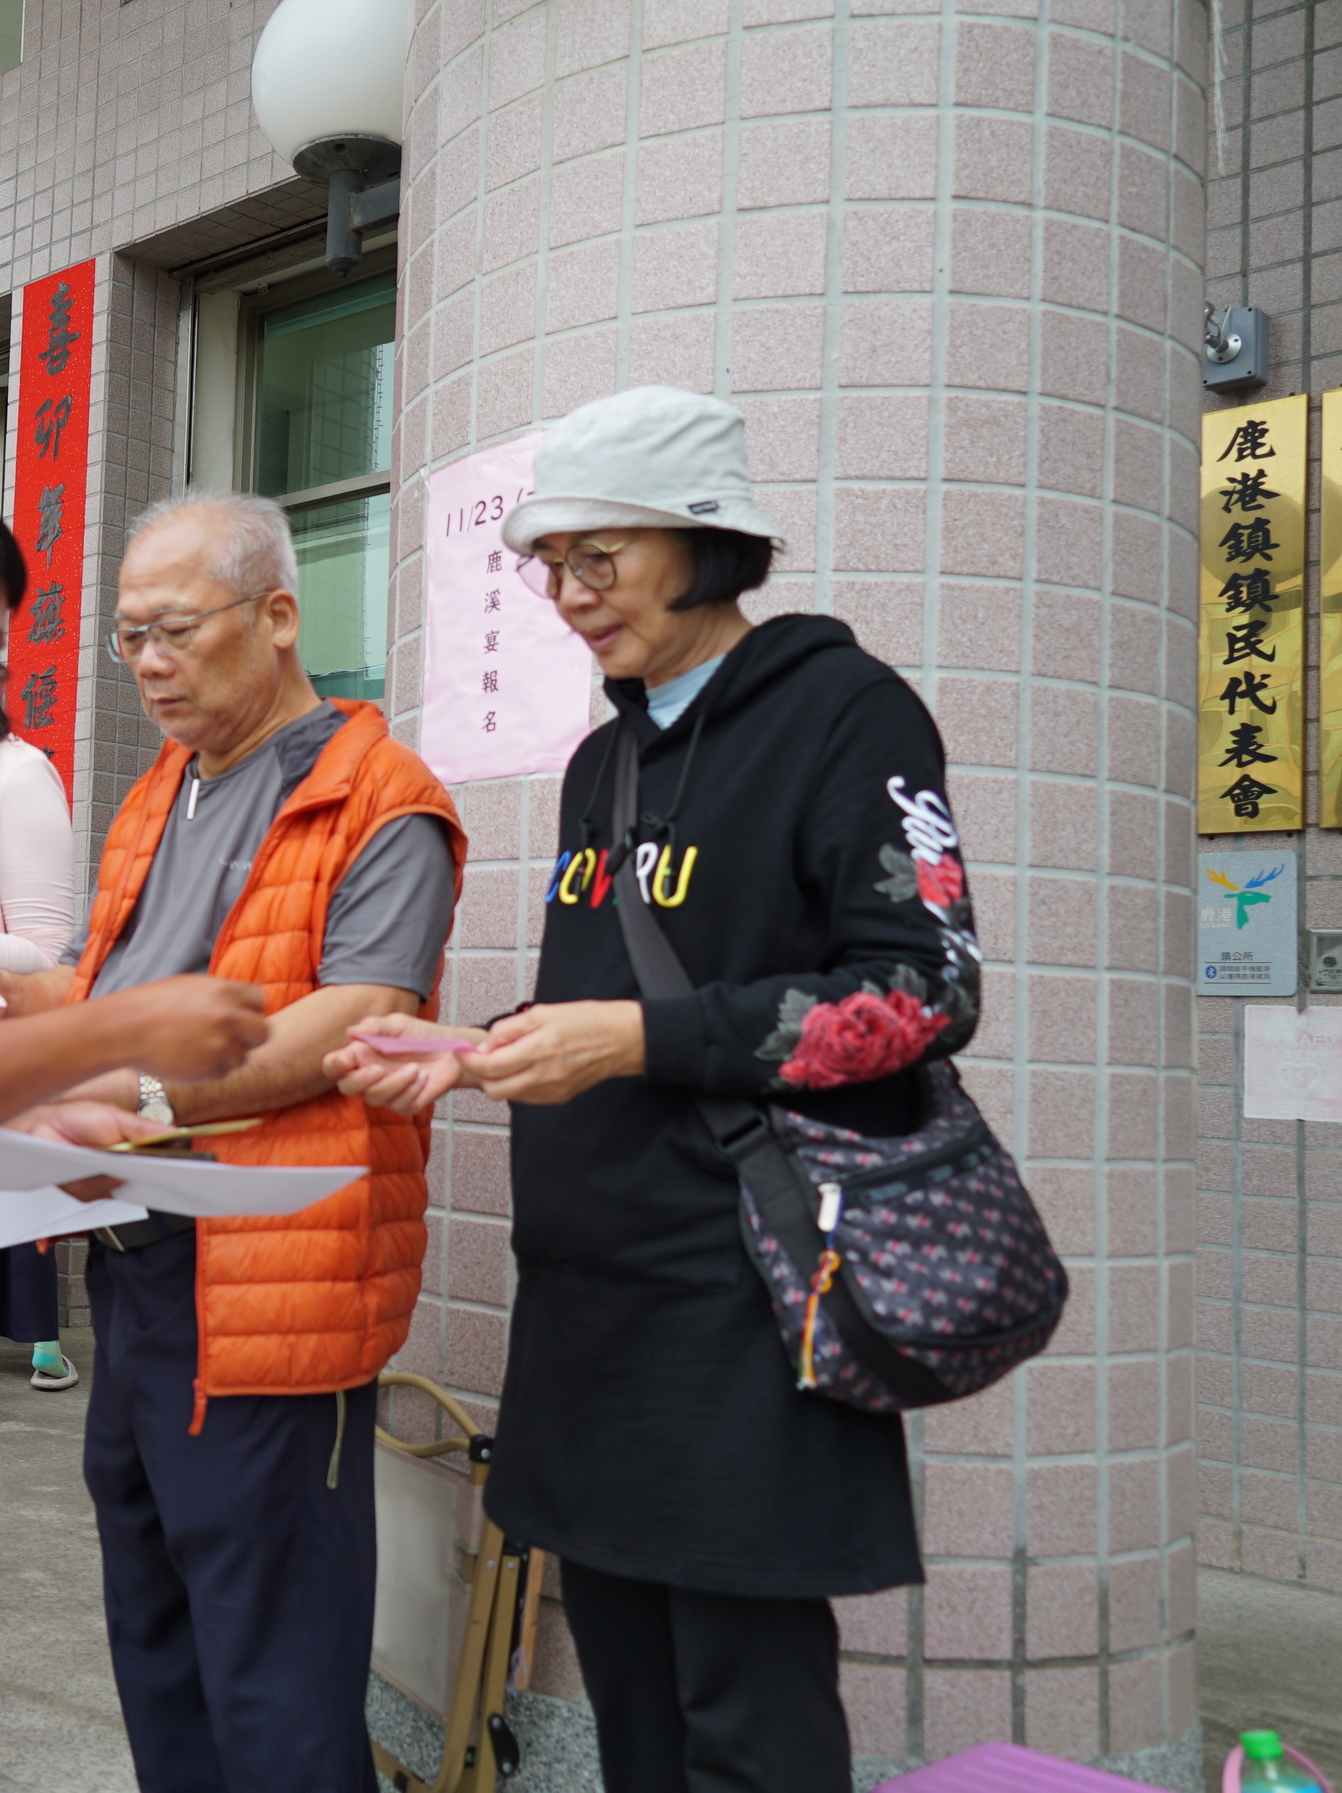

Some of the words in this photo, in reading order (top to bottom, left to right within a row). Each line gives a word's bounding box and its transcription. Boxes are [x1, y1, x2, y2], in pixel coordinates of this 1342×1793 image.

[445, 494, 505, 538] 11/23
[480, 549, 504, 734] 鹿溪宴報名
[1216, 419, 1281, 820] 鹿港鎮鎮民代表會
